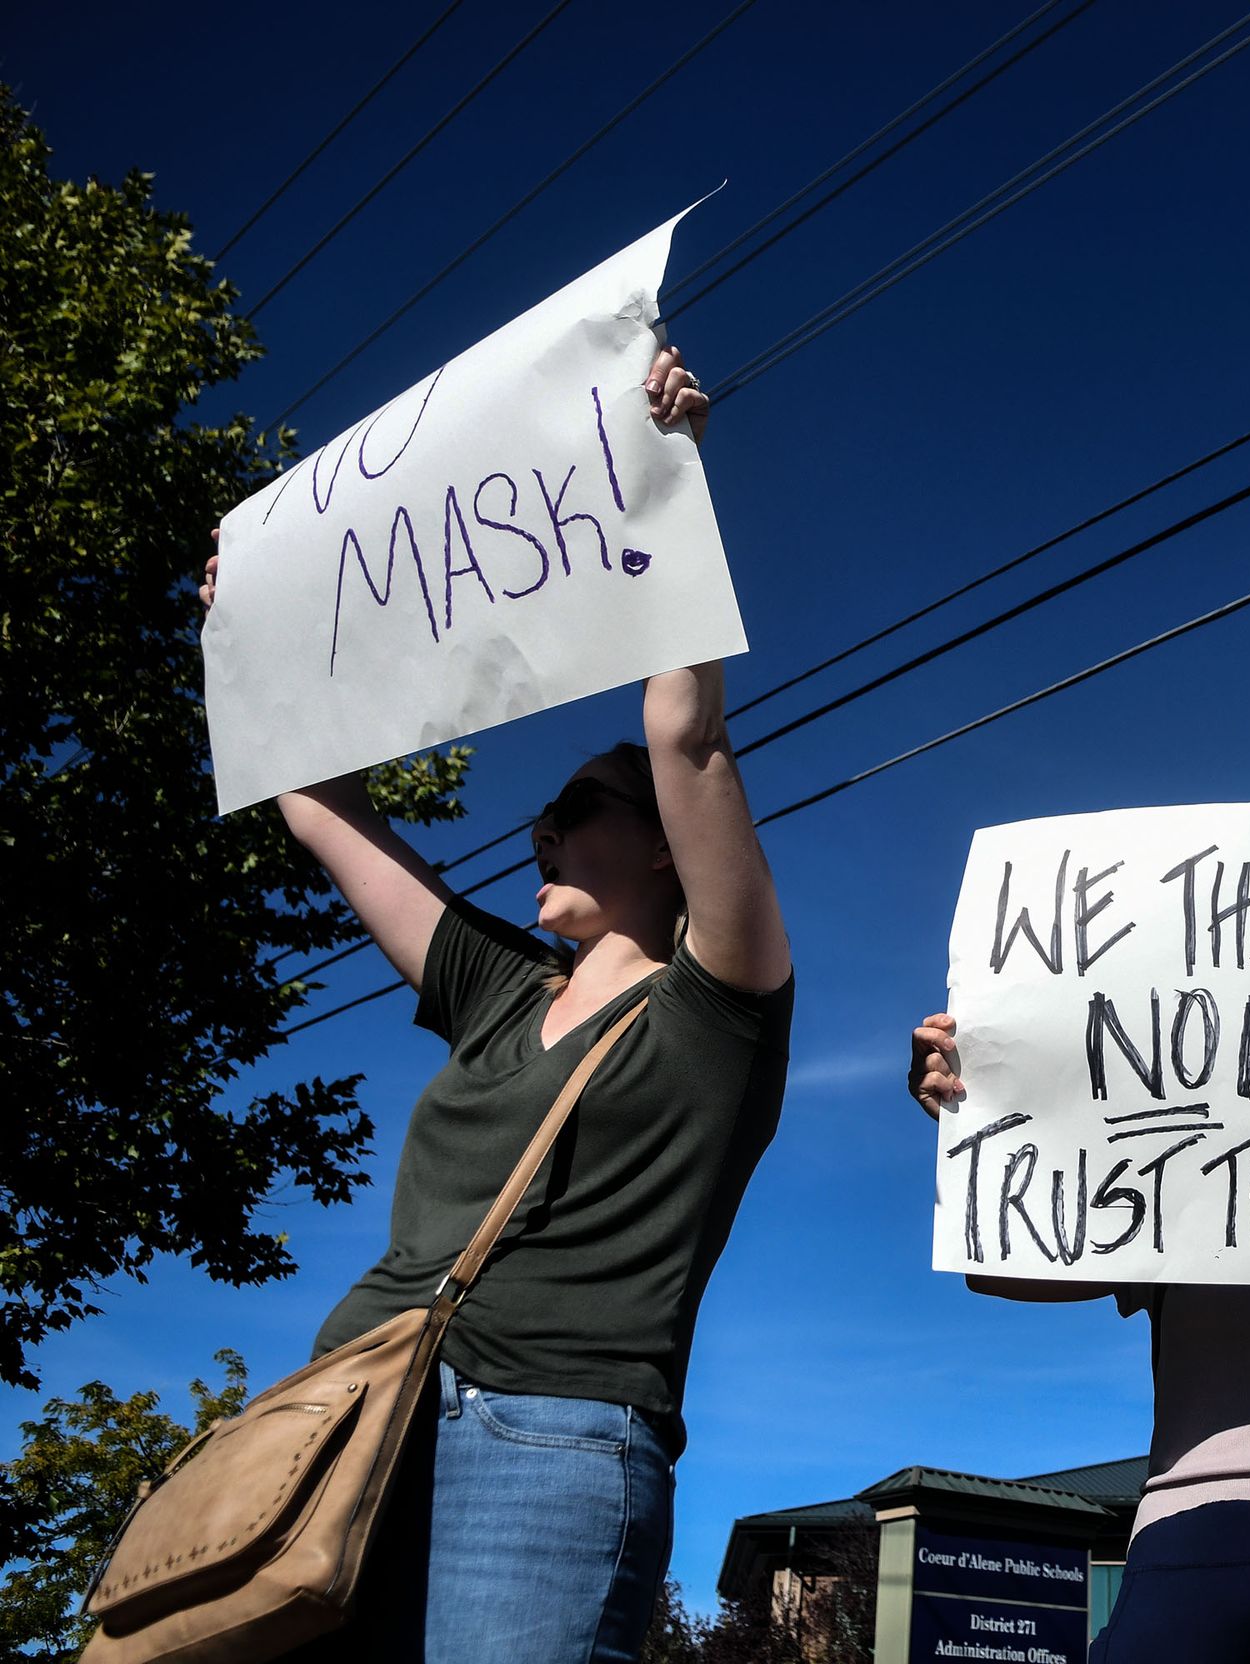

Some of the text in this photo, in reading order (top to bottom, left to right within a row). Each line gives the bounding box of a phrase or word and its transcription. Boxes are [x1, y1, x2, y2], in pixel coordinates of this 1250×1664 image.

[263, 364, 446, 525] NO
[330, 386, 653, 678] MASK!
[989, 848, 1137, 977] WE
[1086, 986, 1221, 1101] NO
[946, 1111, 1207, 1267] TRUST
[918, 1547, 957, 1567] Coeur
[1004, 1557, 1041, 1577] Public
[1042, 1562, 1084, 1583] Schools
[970, 1613, 1037, 1636] District 271
[935, 1639, 1068, 1664] Administration Offices
